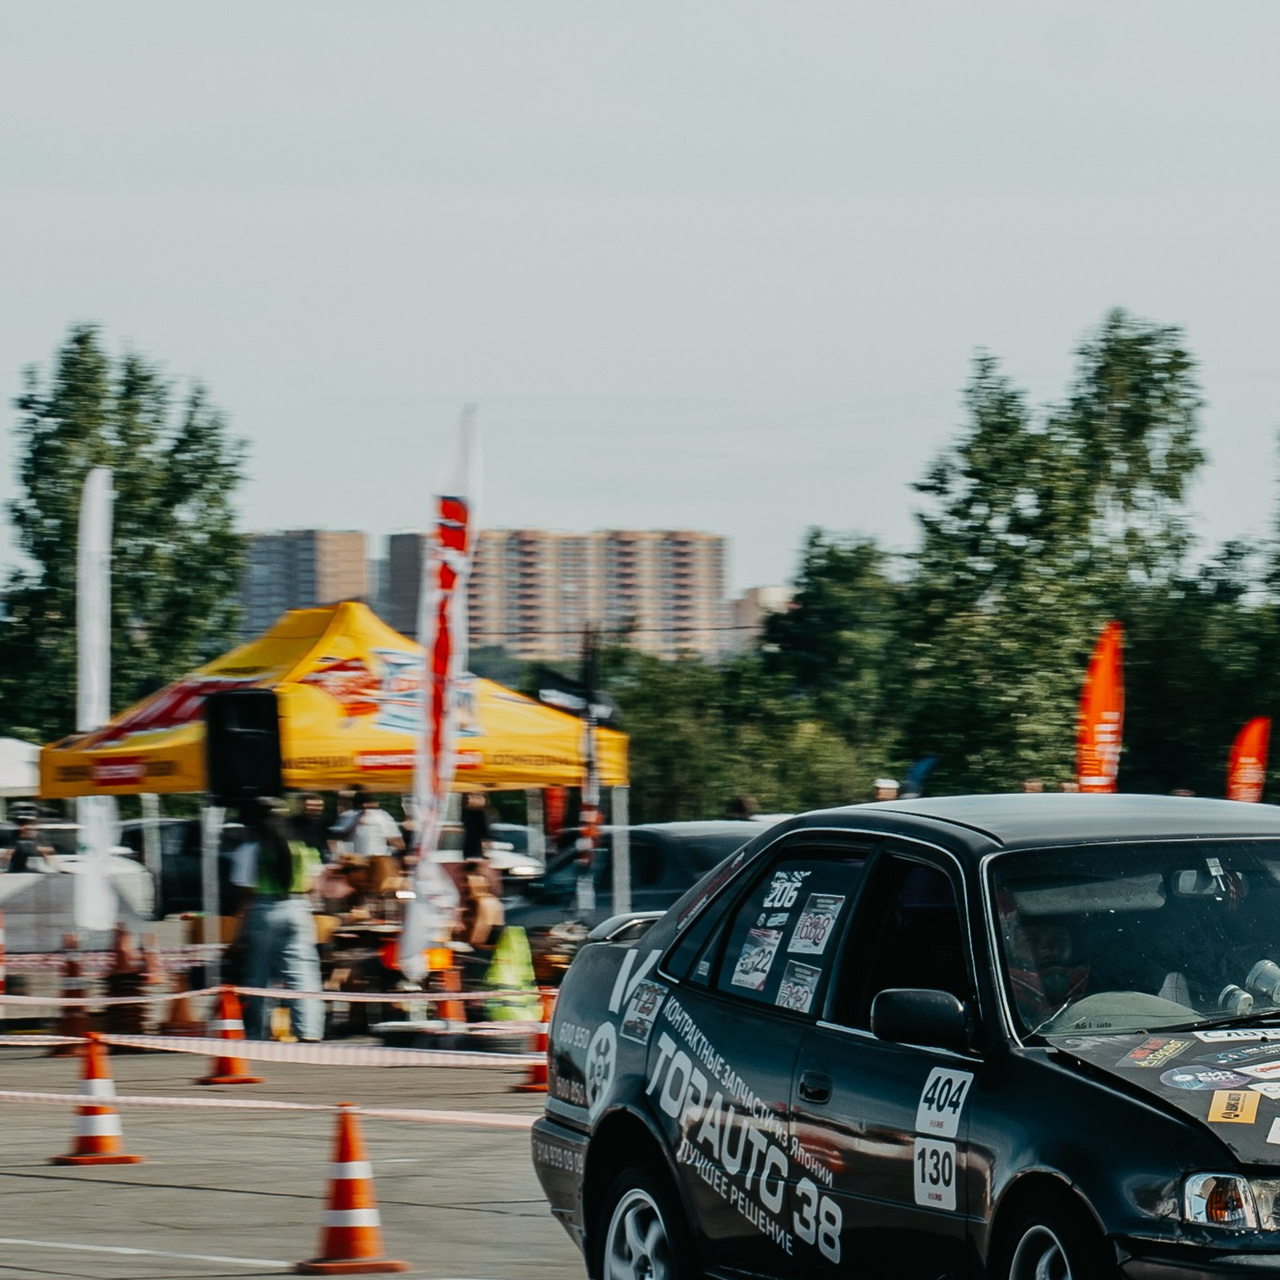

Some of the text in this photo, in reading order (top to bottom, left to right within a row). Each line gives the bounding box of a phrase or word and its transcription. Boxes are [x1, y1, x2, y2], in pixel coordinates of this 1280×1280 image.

[763, 881, 802, 907] 206
[663, 995, 725, 1079] КОНТРАКТНЫЕ
[721, 1064, 775, 1132] ЗАПЧАСТИ
[923, 1076, 967, 1115] 404
[677, 1137, 794, 1256] ЛУЧШЕЕ РЕШЕНИЕ
[917, 1147, 953, 1188] 130
[793, 1177, 843, 1264] 38
